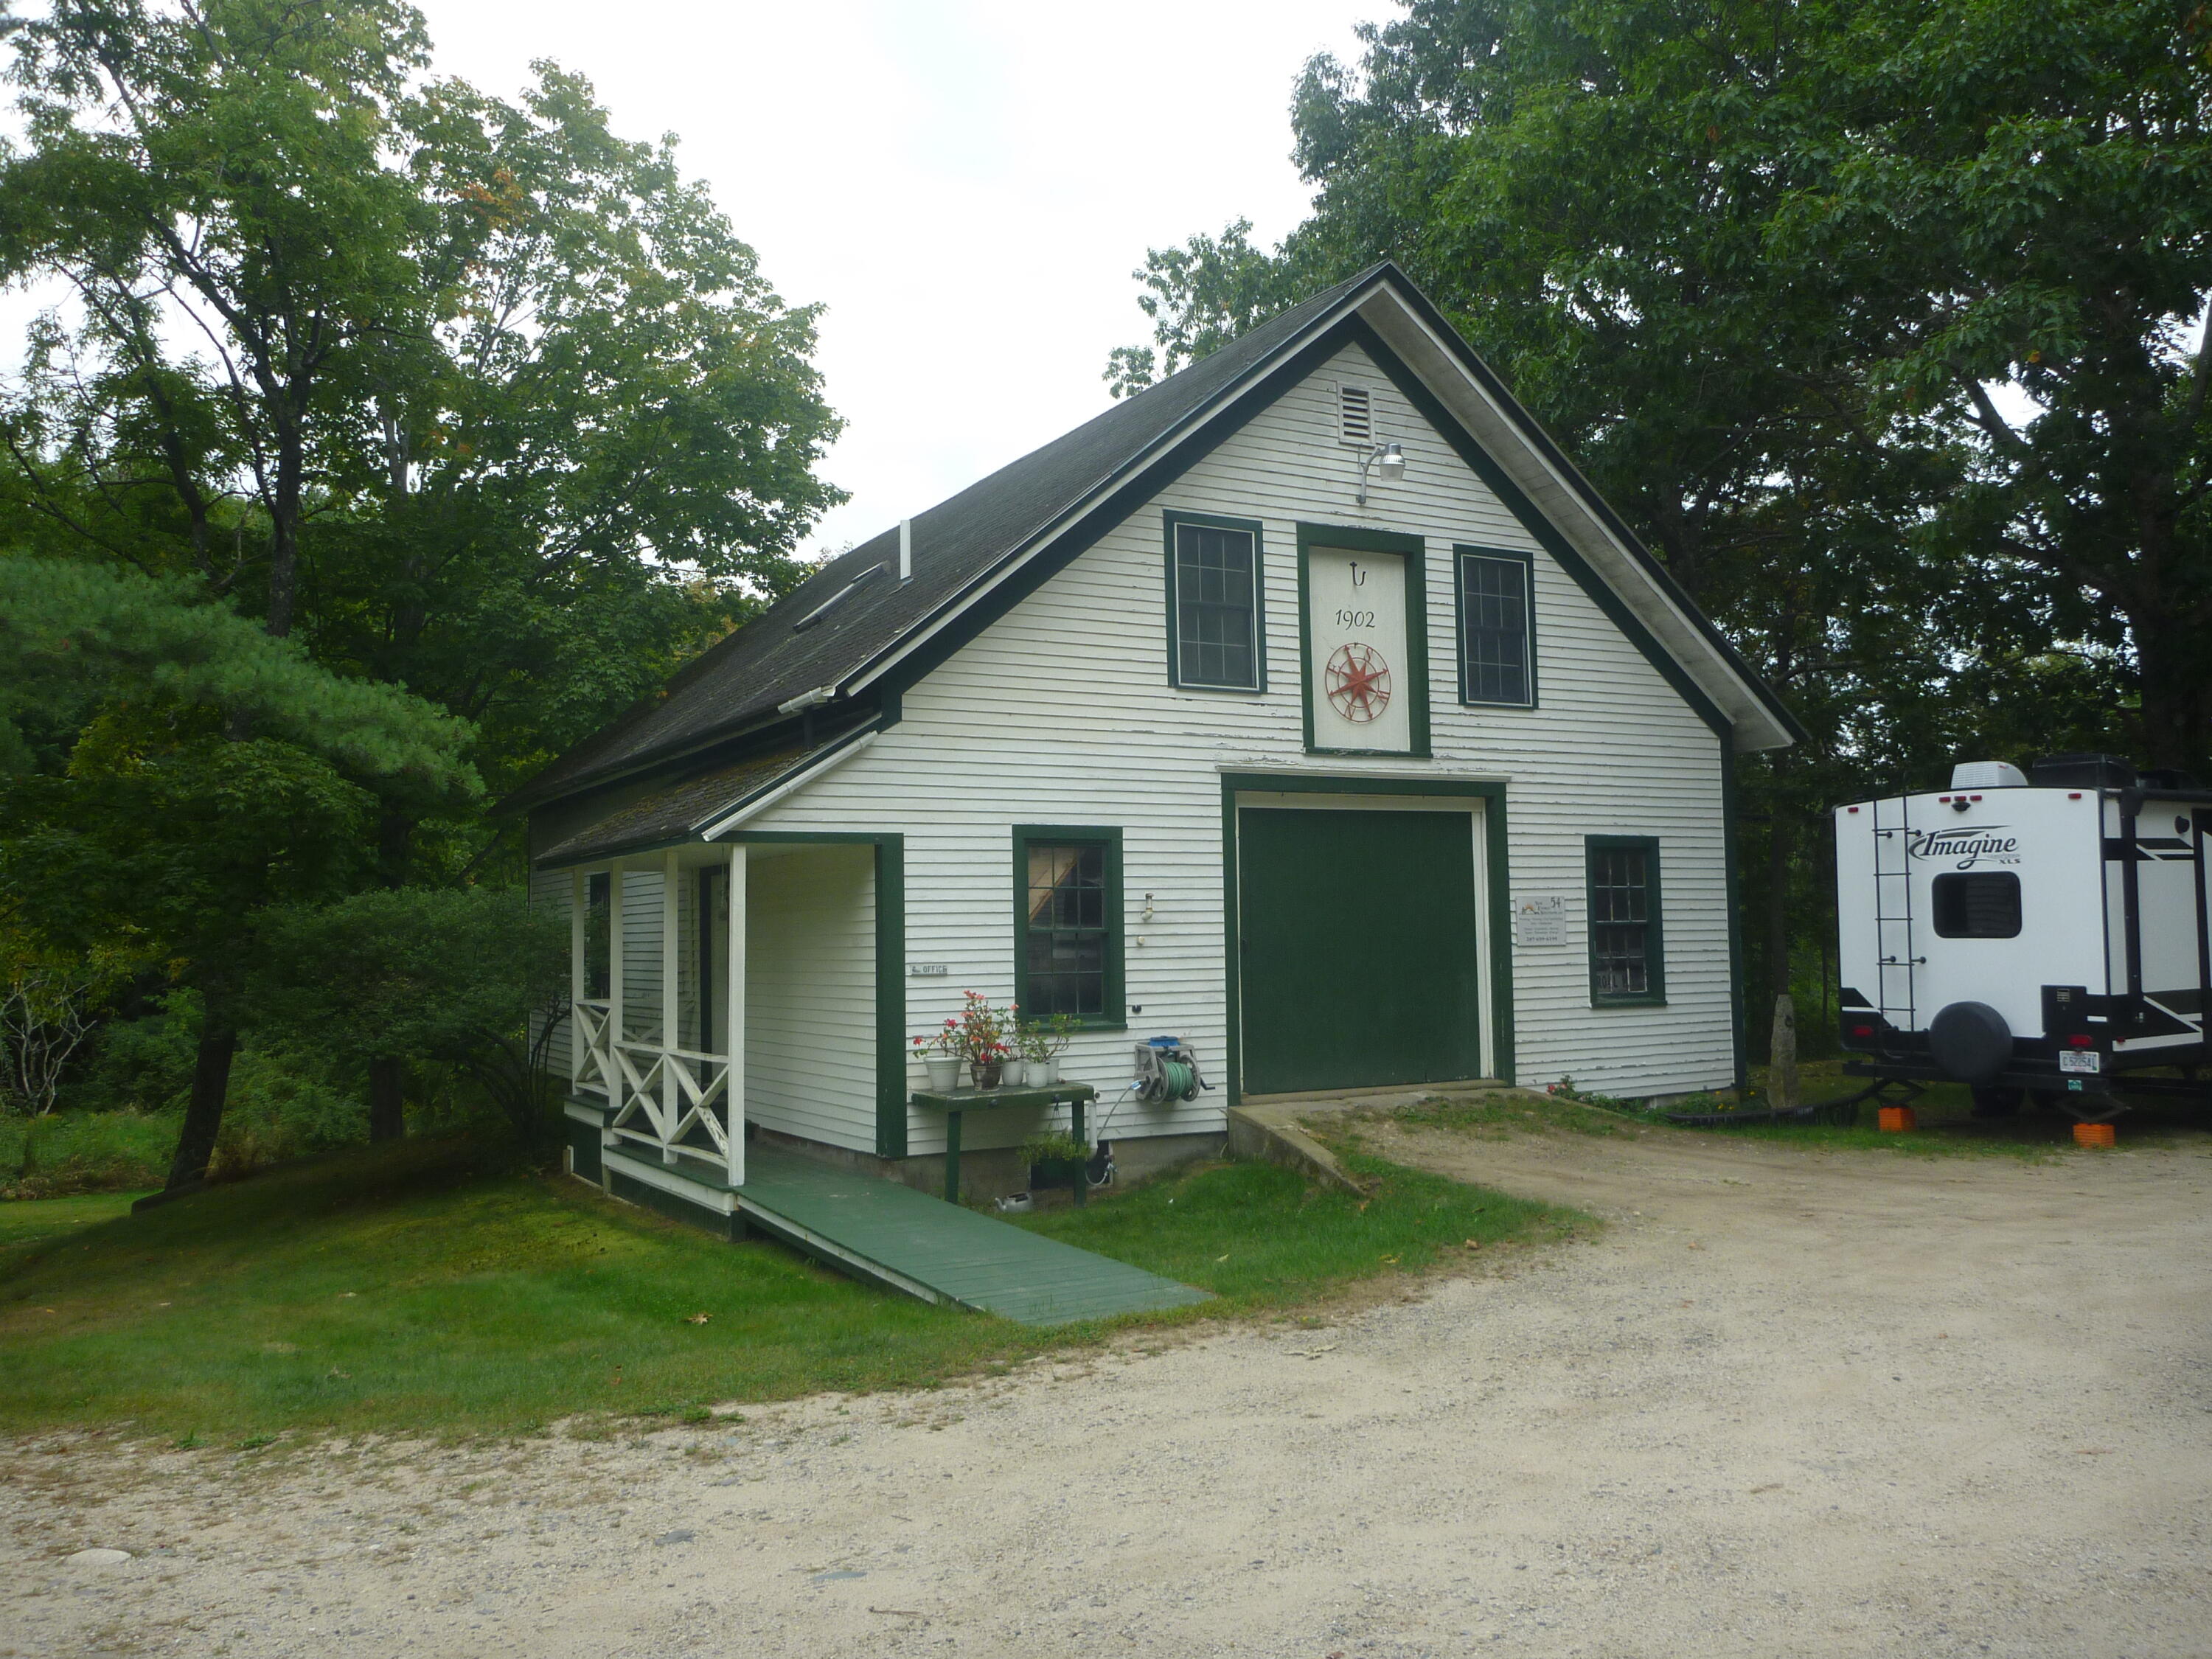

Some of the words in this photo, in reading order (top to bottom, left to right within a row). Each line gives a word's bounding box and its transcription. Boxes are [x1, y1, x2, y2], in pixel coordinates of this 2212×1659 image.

[1335, 609, 1375, 630] 1902
[1919, 831, 2020, 869] Imagine
[1551, 897, 1561, 908] 54
[922, 965, 947, 973] OFFICE
